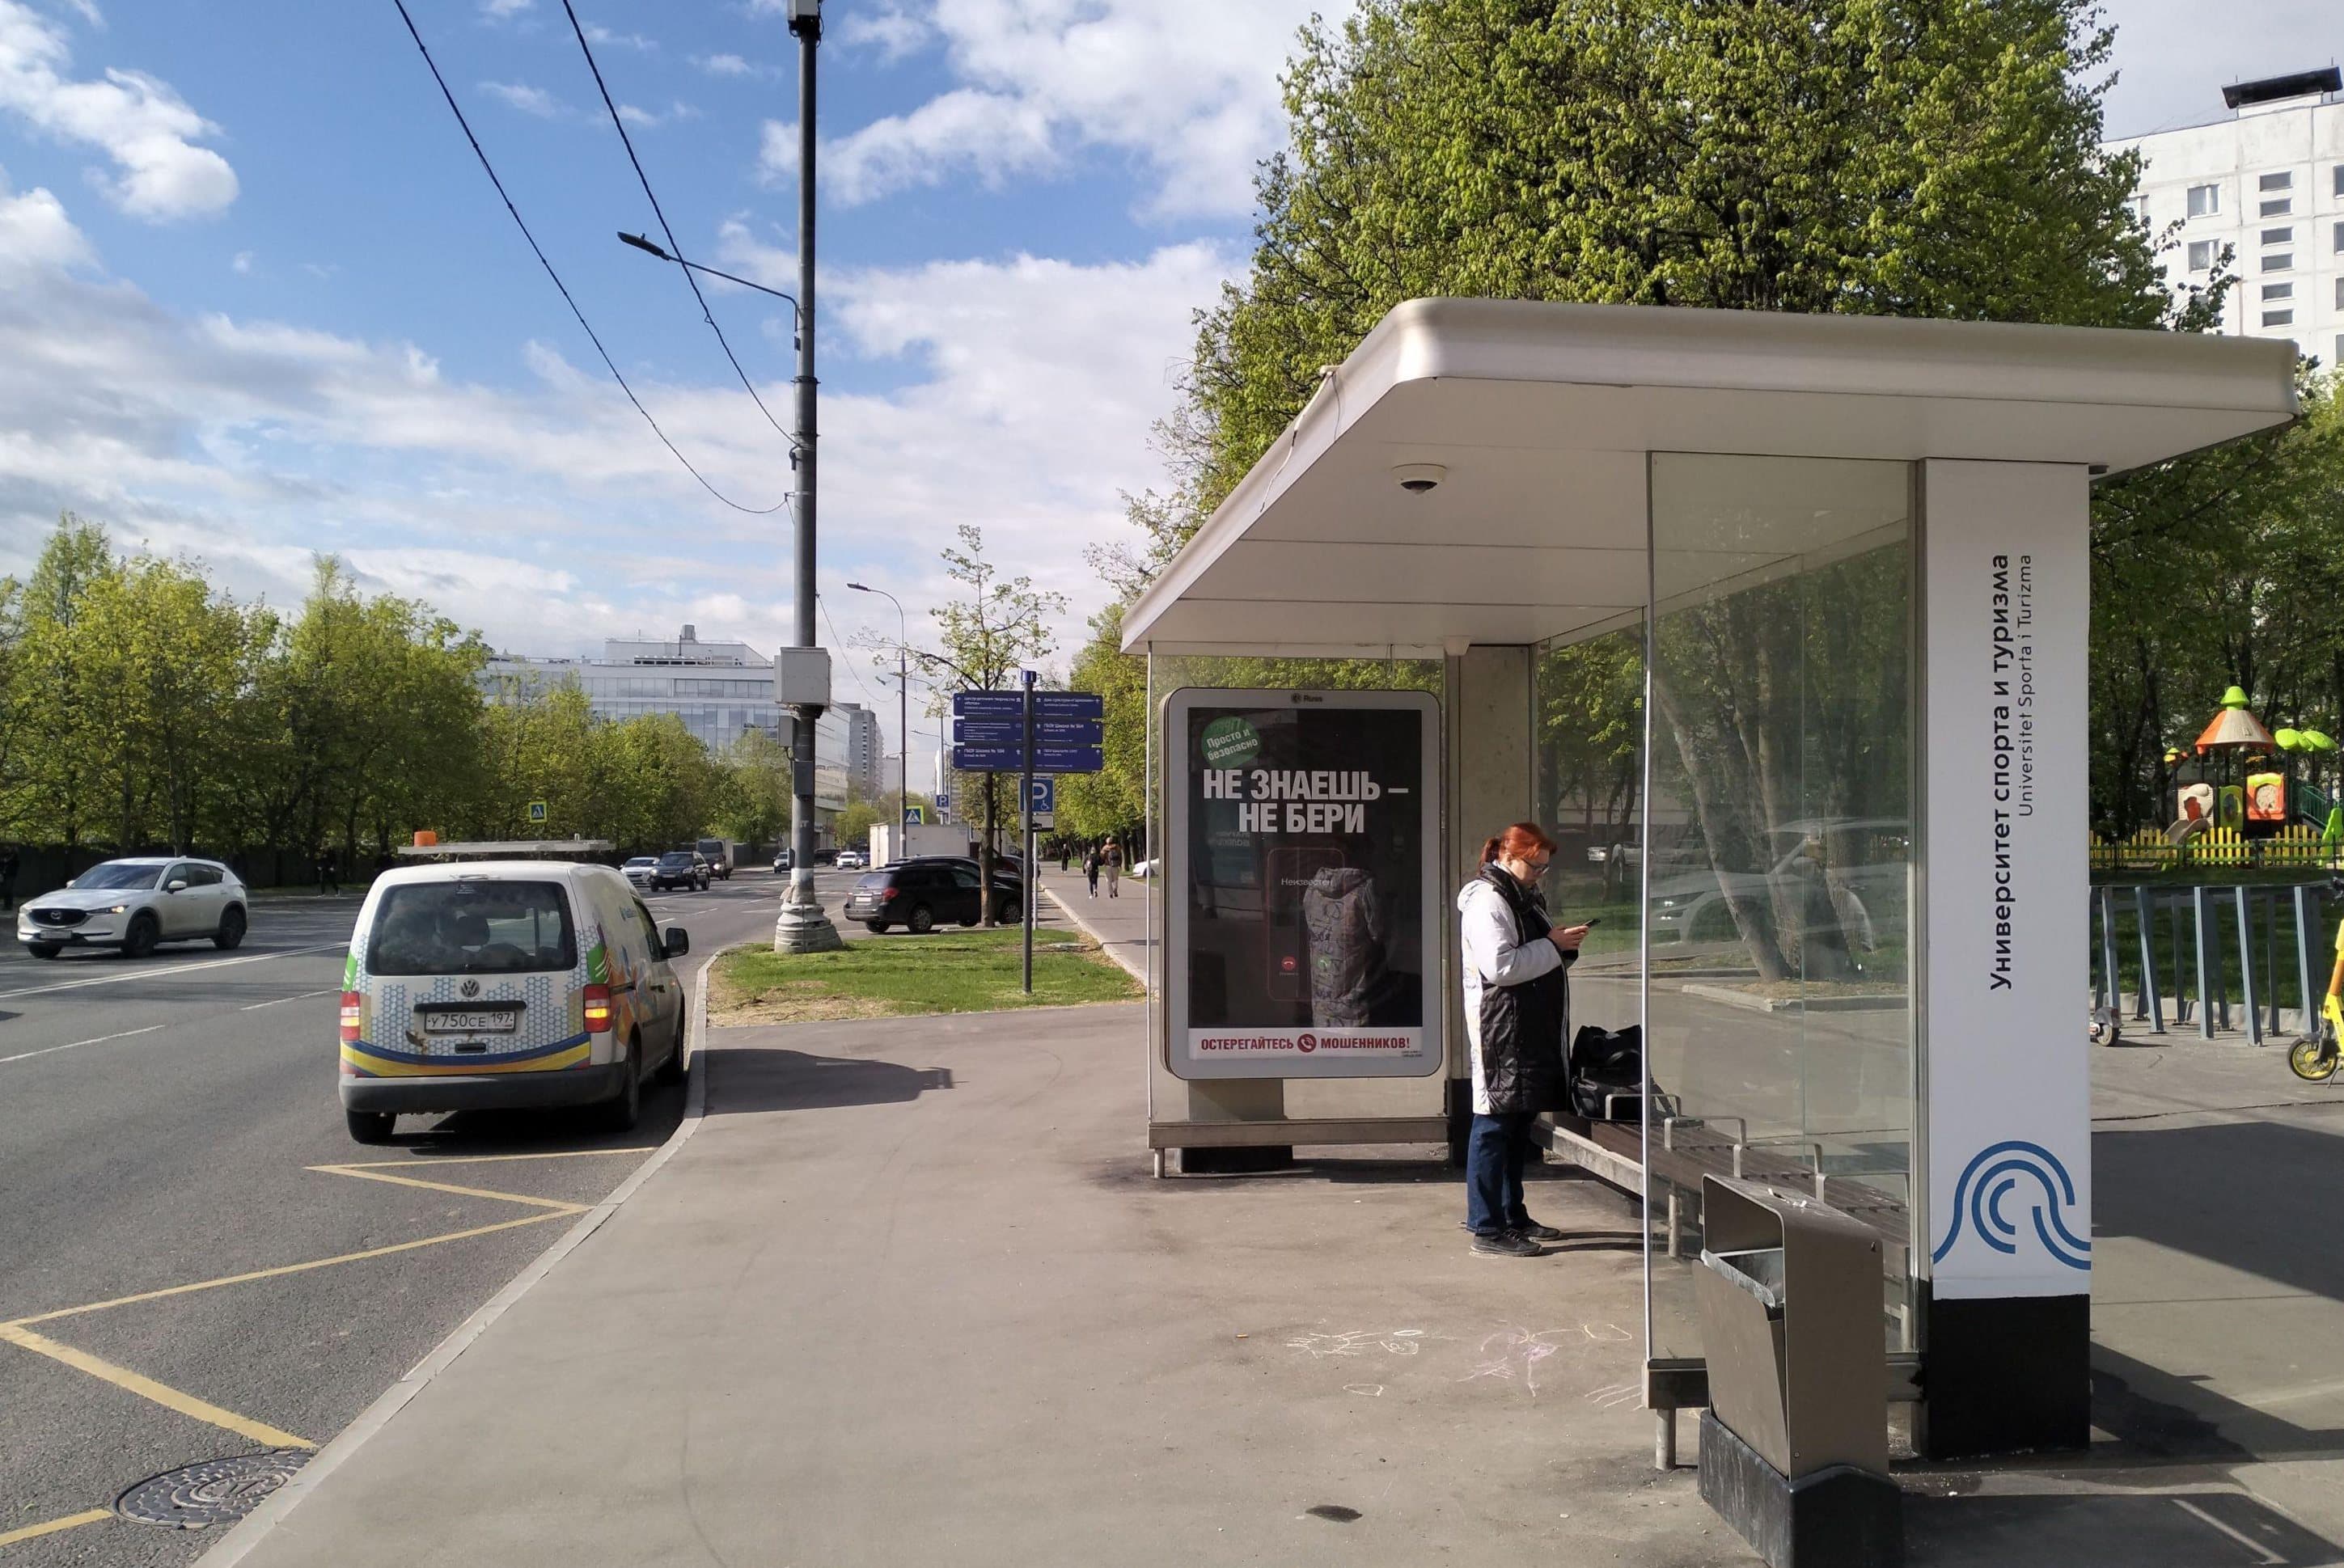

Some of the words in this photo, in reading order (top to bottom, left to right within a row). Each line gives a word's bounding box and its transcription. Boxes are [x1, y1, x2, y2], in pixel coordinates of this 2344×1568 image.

[2016, 555, 2032, 629] Turizma
[1992, 555, 2014, 674] туризма
[1994, 681, 2009, 695] и
[2017, 646, 2036, 708] Sporta
[1207, 730, 1242, 750] Просто
[1242, 728, 1251, 738] и
[1207, 738, 1259, 762] безопасно
[1993, 706, 2015, 801] спорта
[2018, 712, 2033, 817] Universitet
[1203, 769, 1243, 799] НЕ
[1250, 769, 1381, 801] ЗНАЕШЬ
[1238, 803, 1278, 833] НЕ
[1286, 803, 1365, 834] БЕРИ
[1990, 809, 2016, 991] Университет
[490, 1012, 511, 1024] 197
[1201, 1036, 1294, 1050] ОСТЕРЕГАЙТЕСЬ
[1320, 1037, 1410, 1050] МОШЕННИКОВ!
